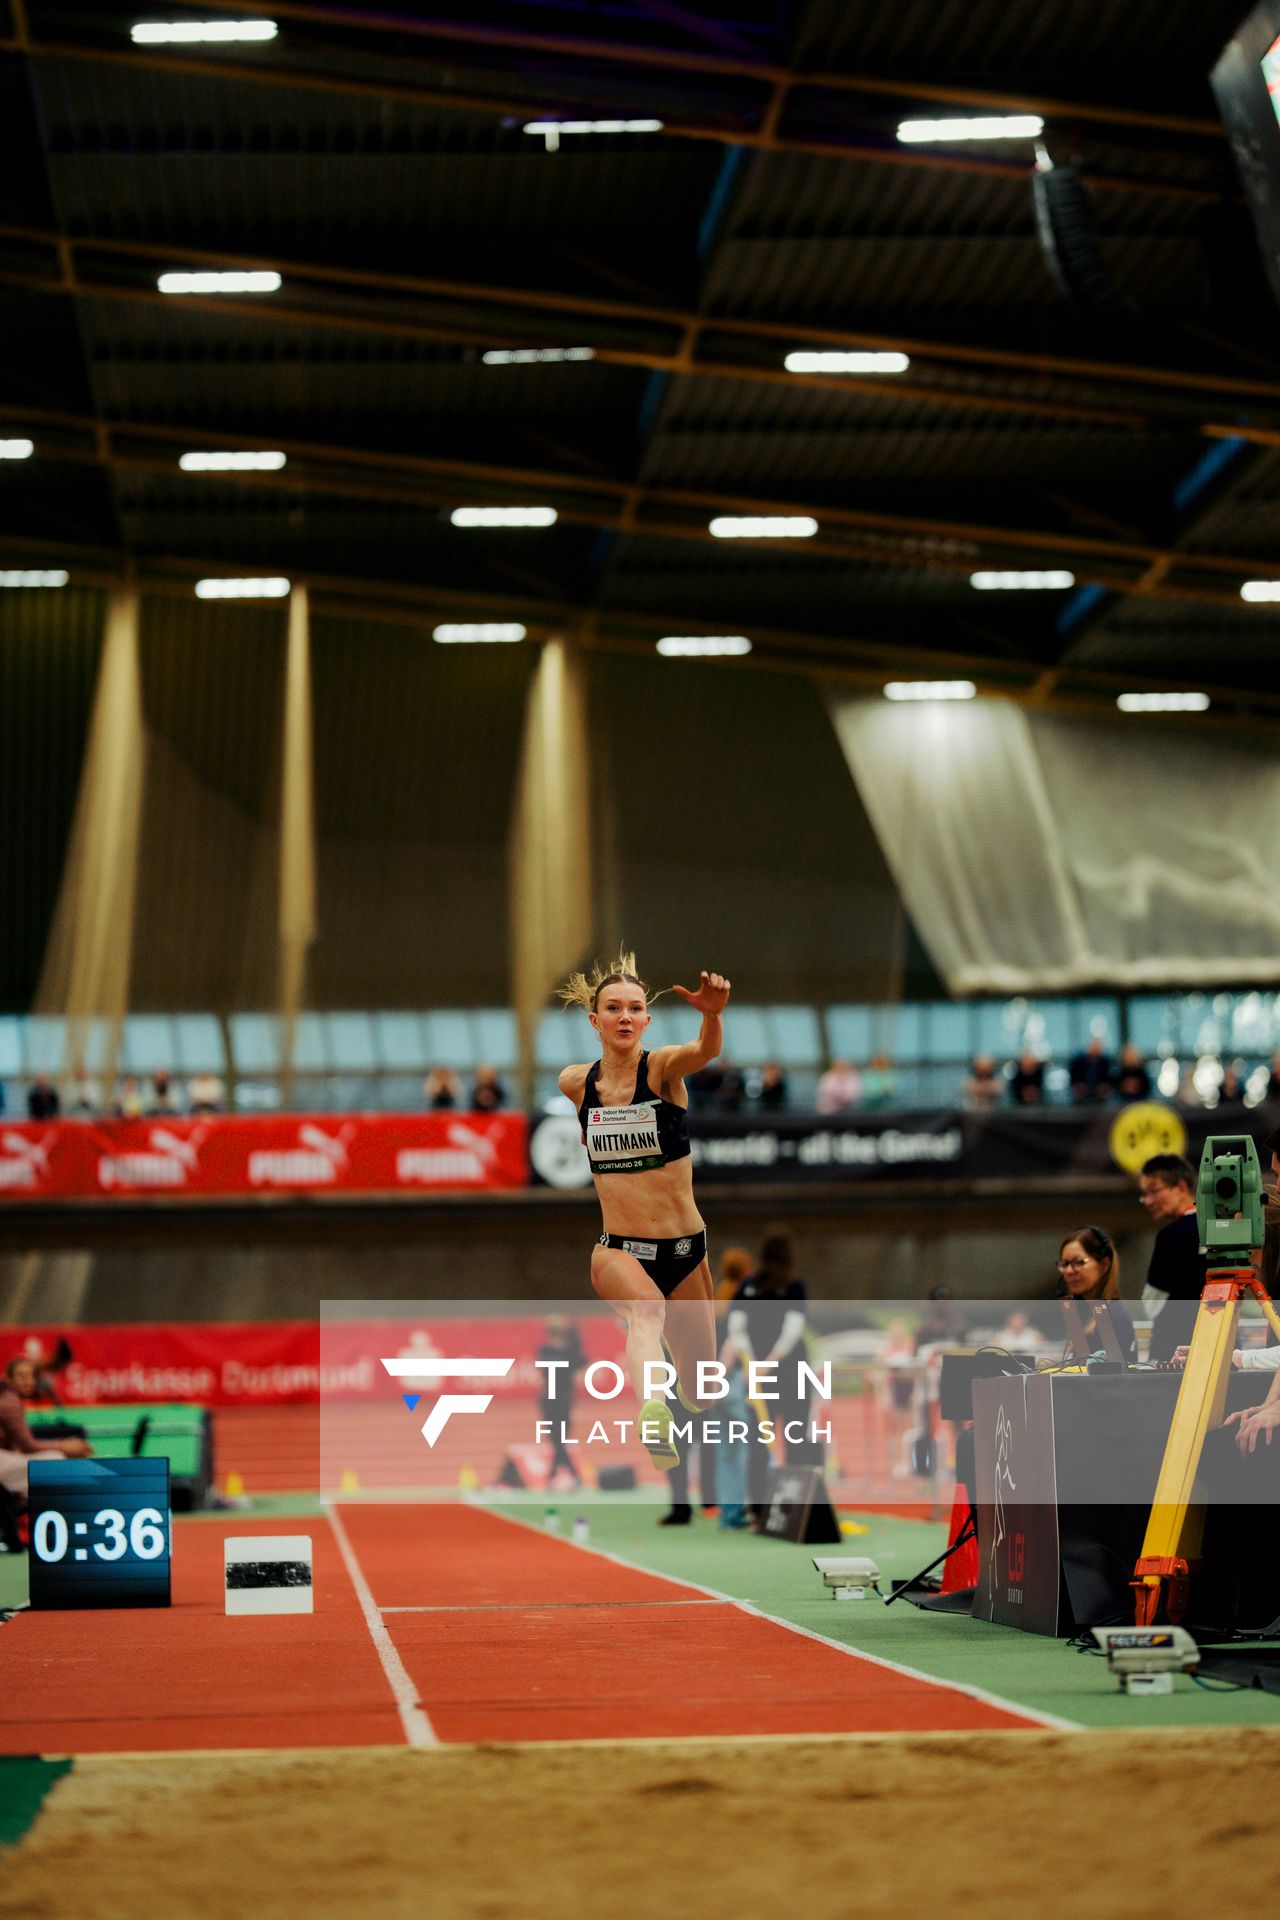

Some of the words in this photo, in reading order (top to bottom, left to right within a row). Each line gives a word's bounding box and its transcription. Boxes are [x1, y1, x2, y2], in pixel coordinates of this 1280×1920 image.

[592, 1131, 657, 1152] WITTMANN
[598, 1161, 633, 1170] DORTMUND
[34, 1508, 165, 1563] 0:36
